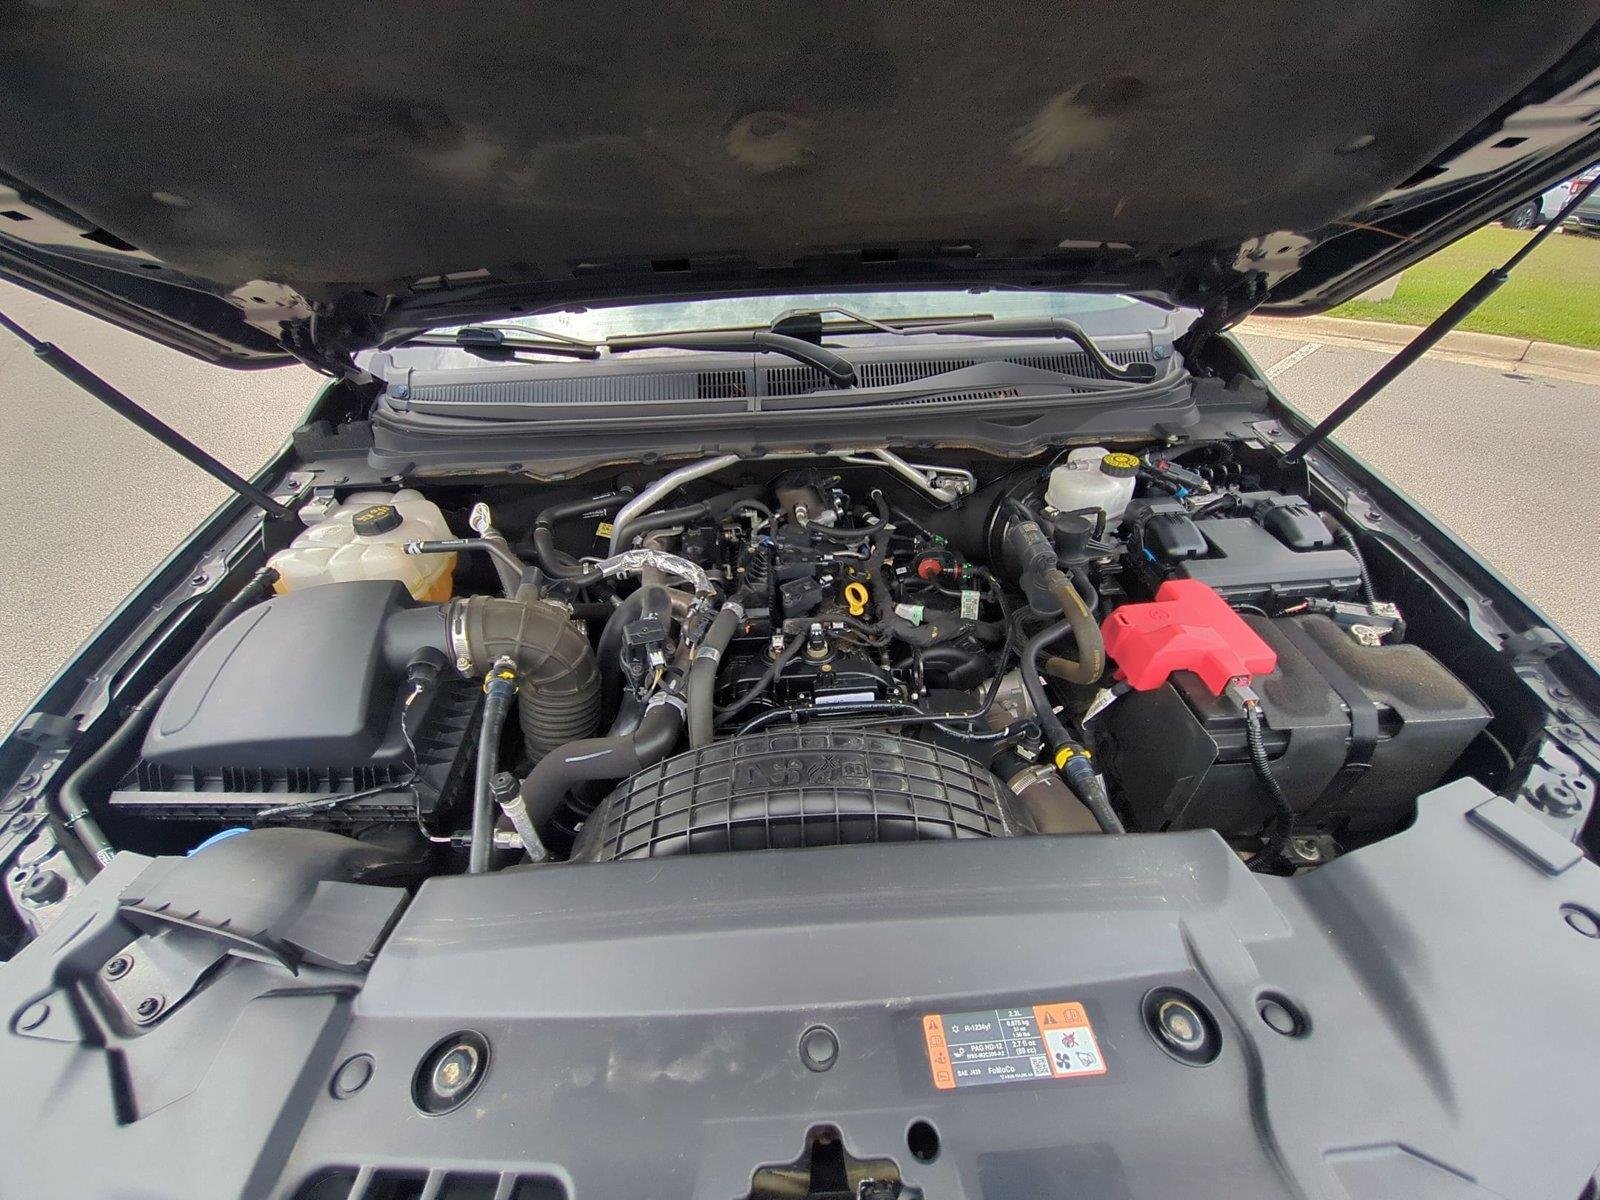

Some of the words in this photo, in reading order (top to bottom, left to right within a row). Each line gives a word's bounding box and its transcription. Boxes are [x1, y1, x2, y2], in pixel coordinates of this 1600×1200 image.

[964, 1022, 992, 1032] R-1234yf
[971, 1044, 984, 1052] PAG
[988, 1065, 1016, 1074] FoMoCo
